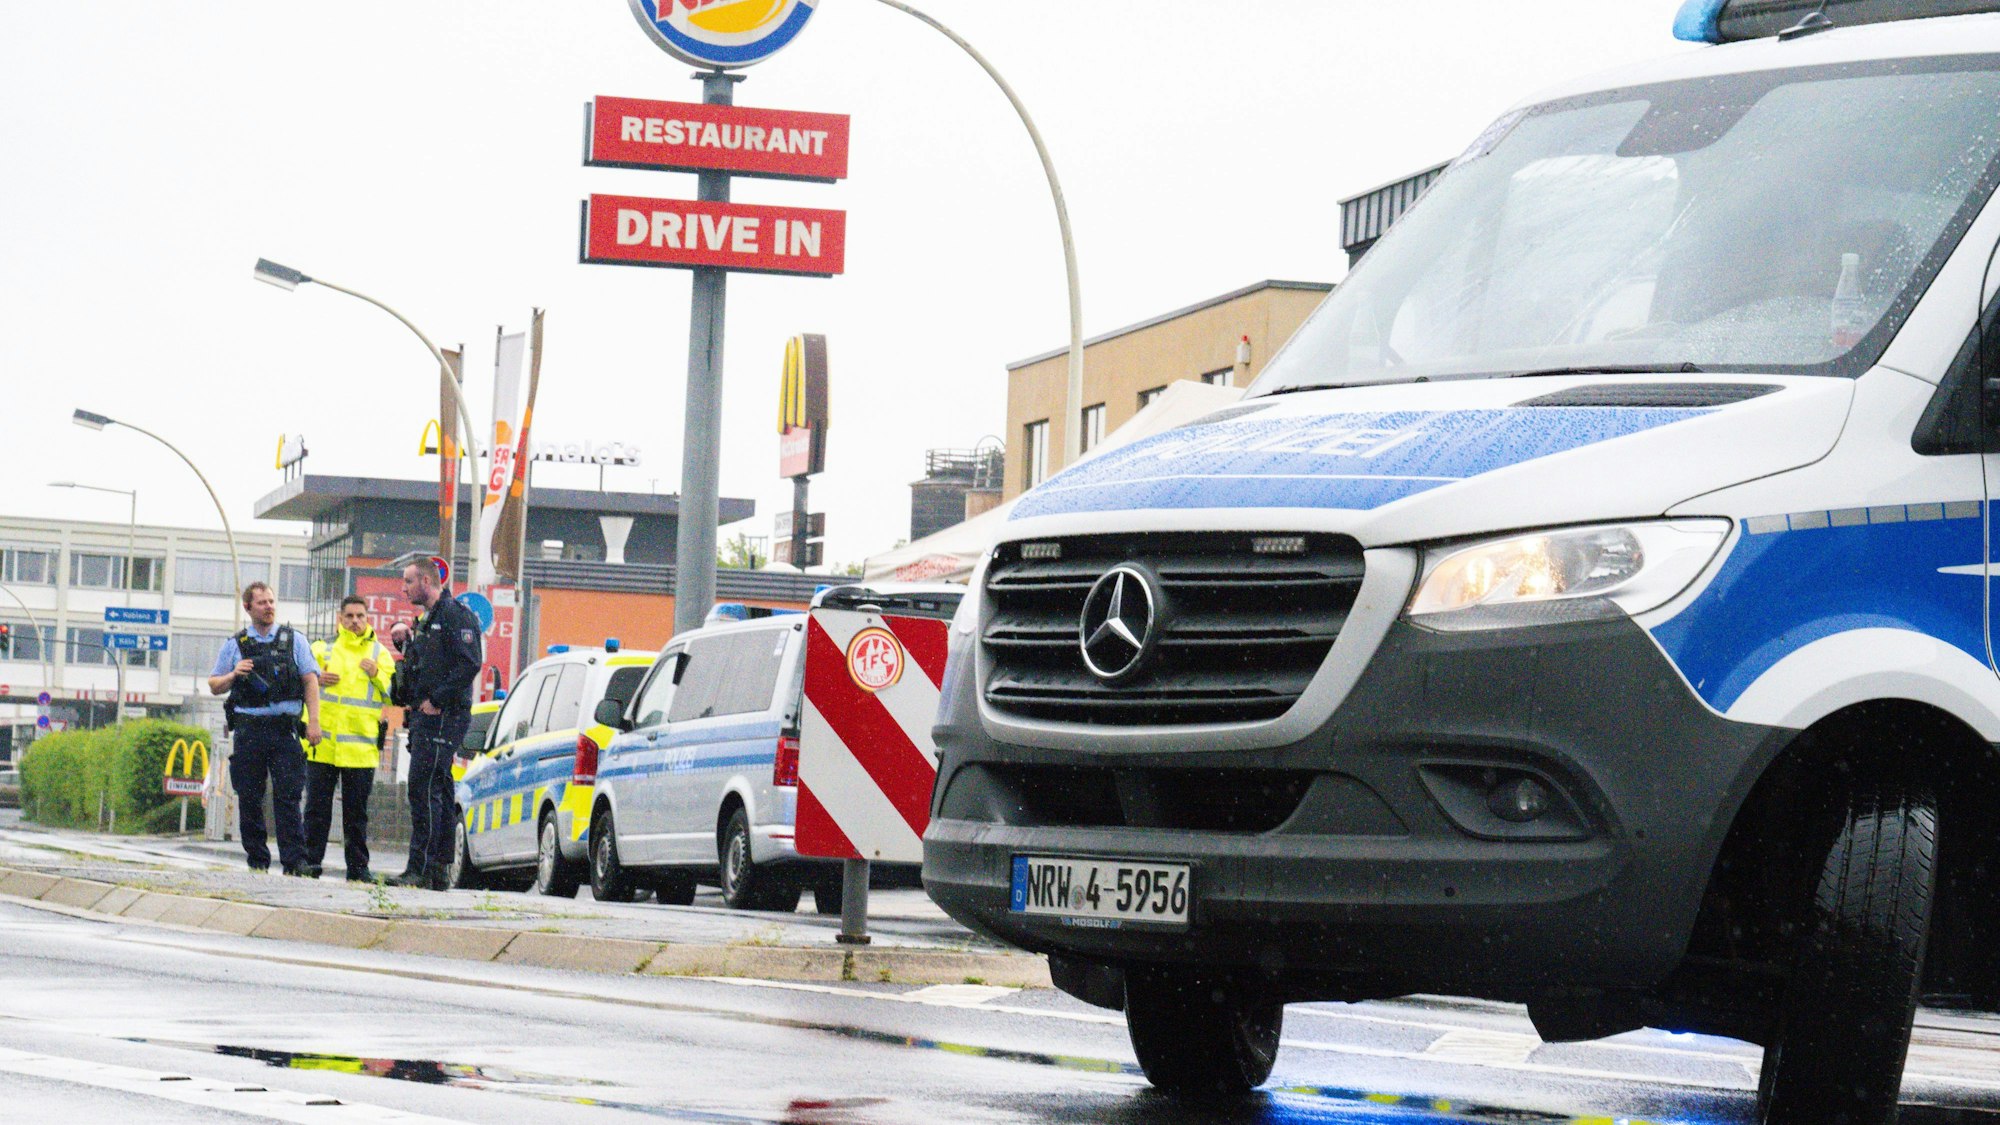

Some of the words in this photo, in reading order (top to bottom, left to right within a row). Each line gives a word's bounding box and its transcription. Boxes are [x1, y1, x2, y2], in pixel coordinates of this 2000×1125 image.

[621, 115, 828, 156] RESTAURANT
[616, 208, 760, 254] DRIVE
[774, 219, 822, 257] IN
[1026, 864, 1072, 909] NRW
[1086, 867, 1187, 915] 4-5956
